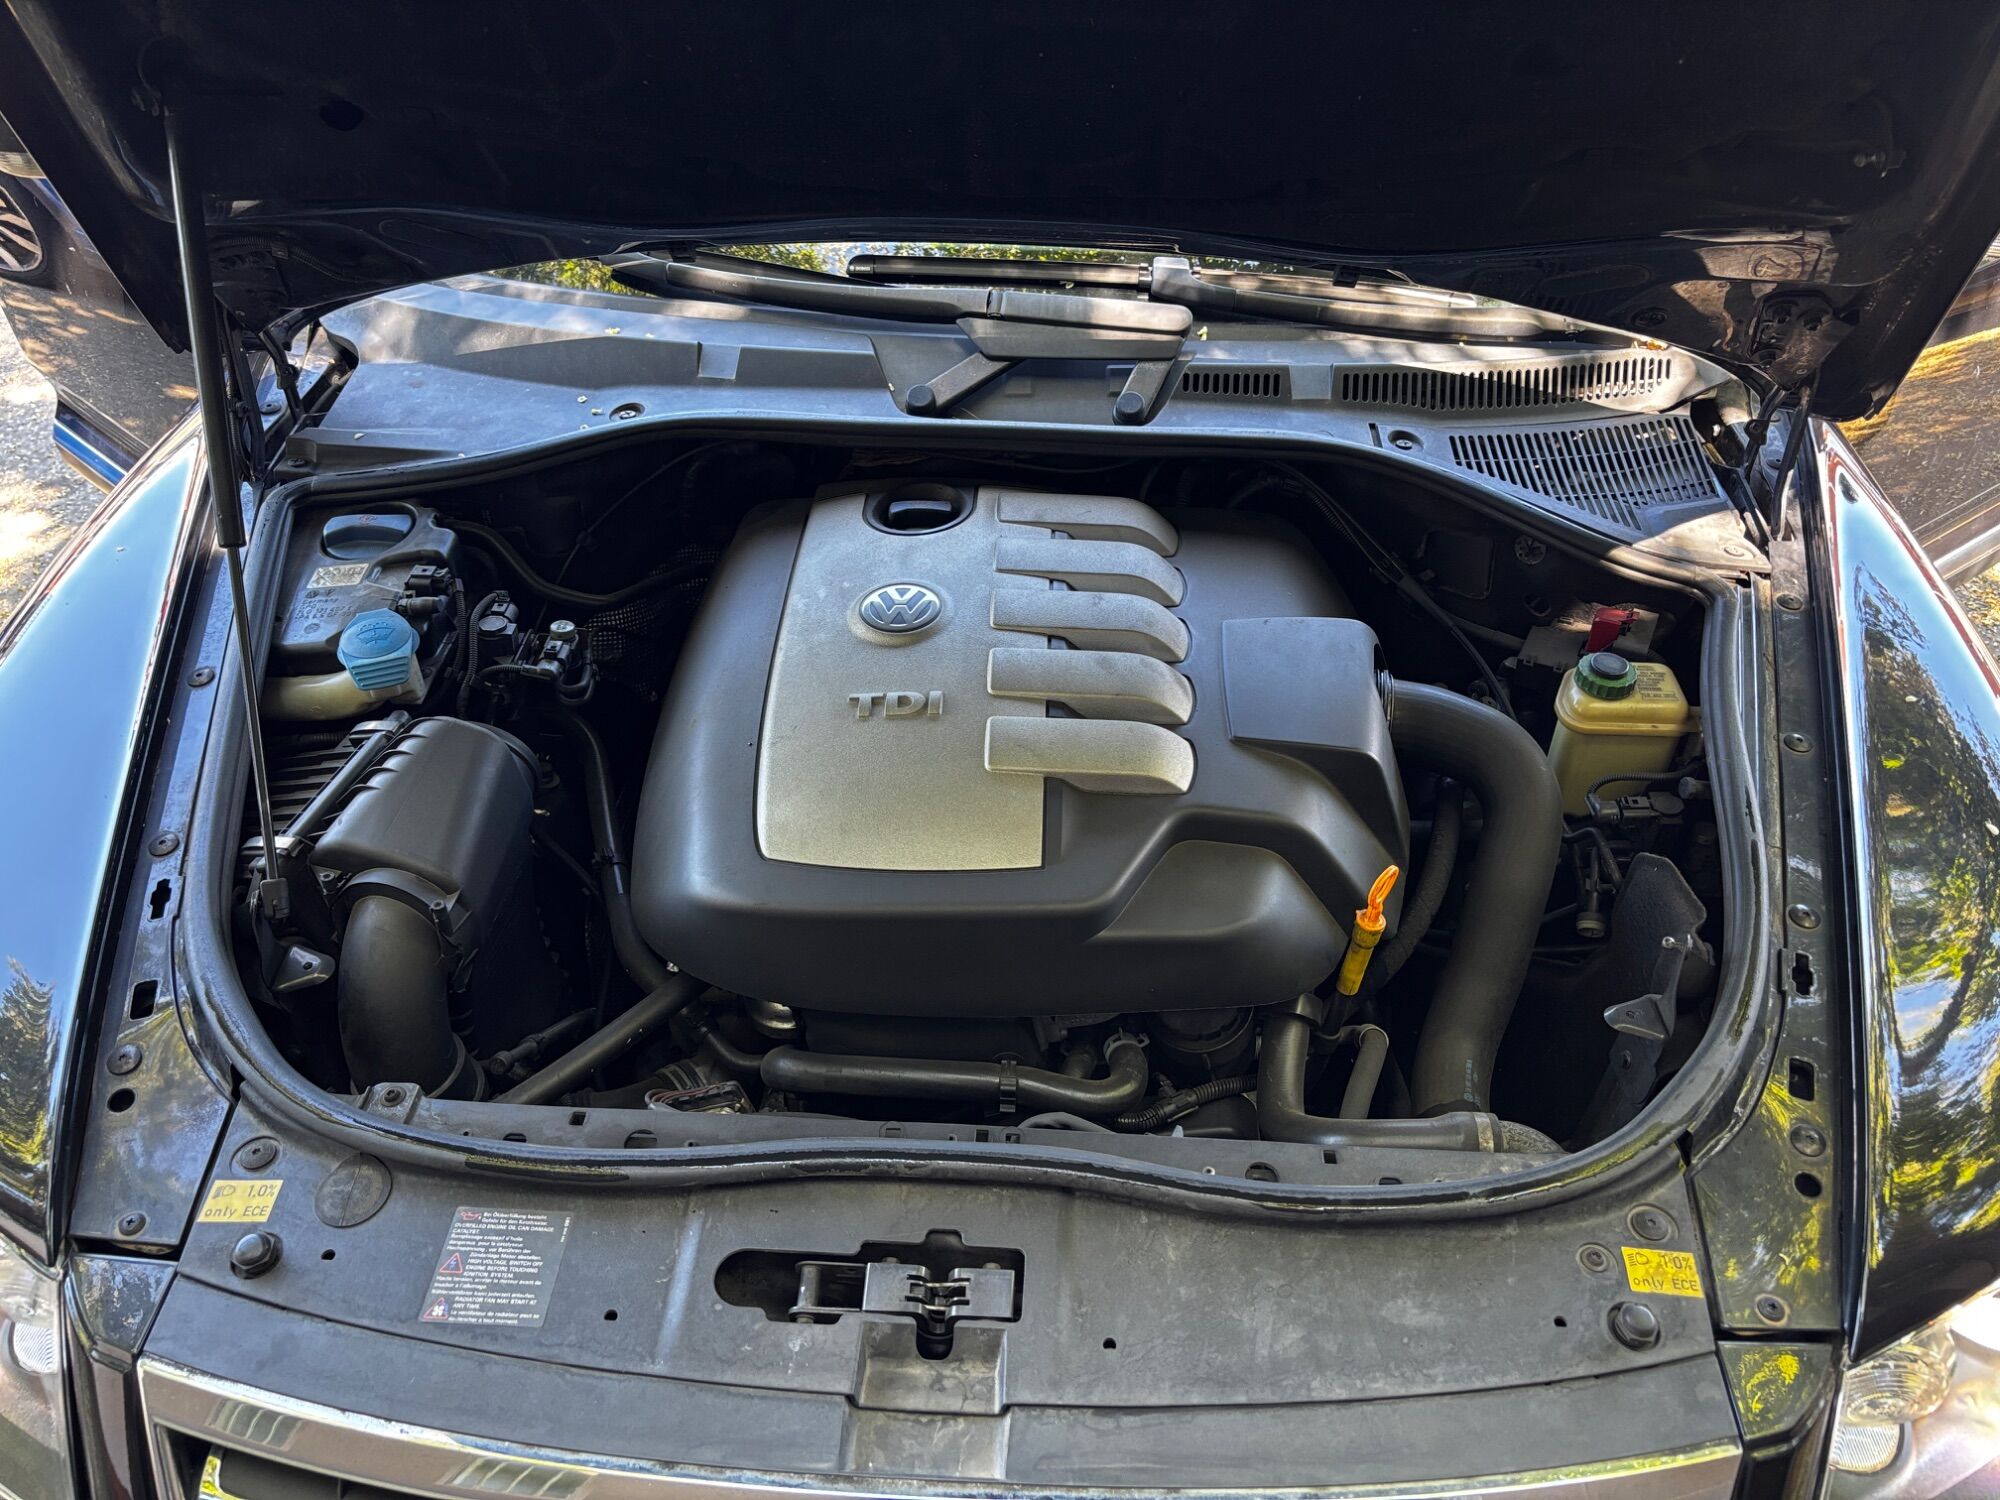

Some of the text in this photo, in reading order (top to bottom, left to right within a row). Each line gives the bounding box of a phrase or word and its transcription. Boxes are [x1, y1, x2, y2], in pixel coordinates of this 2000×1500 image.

[848, 691, 943, 717] TDI
[247, 1184, 277, 1198] 1.0%
[204, 1206, 269, 1219] only ECE
[1661, 1255, 1692, 1270] 1.0%
[1633, 1276, 1699, 1292] only ECE
